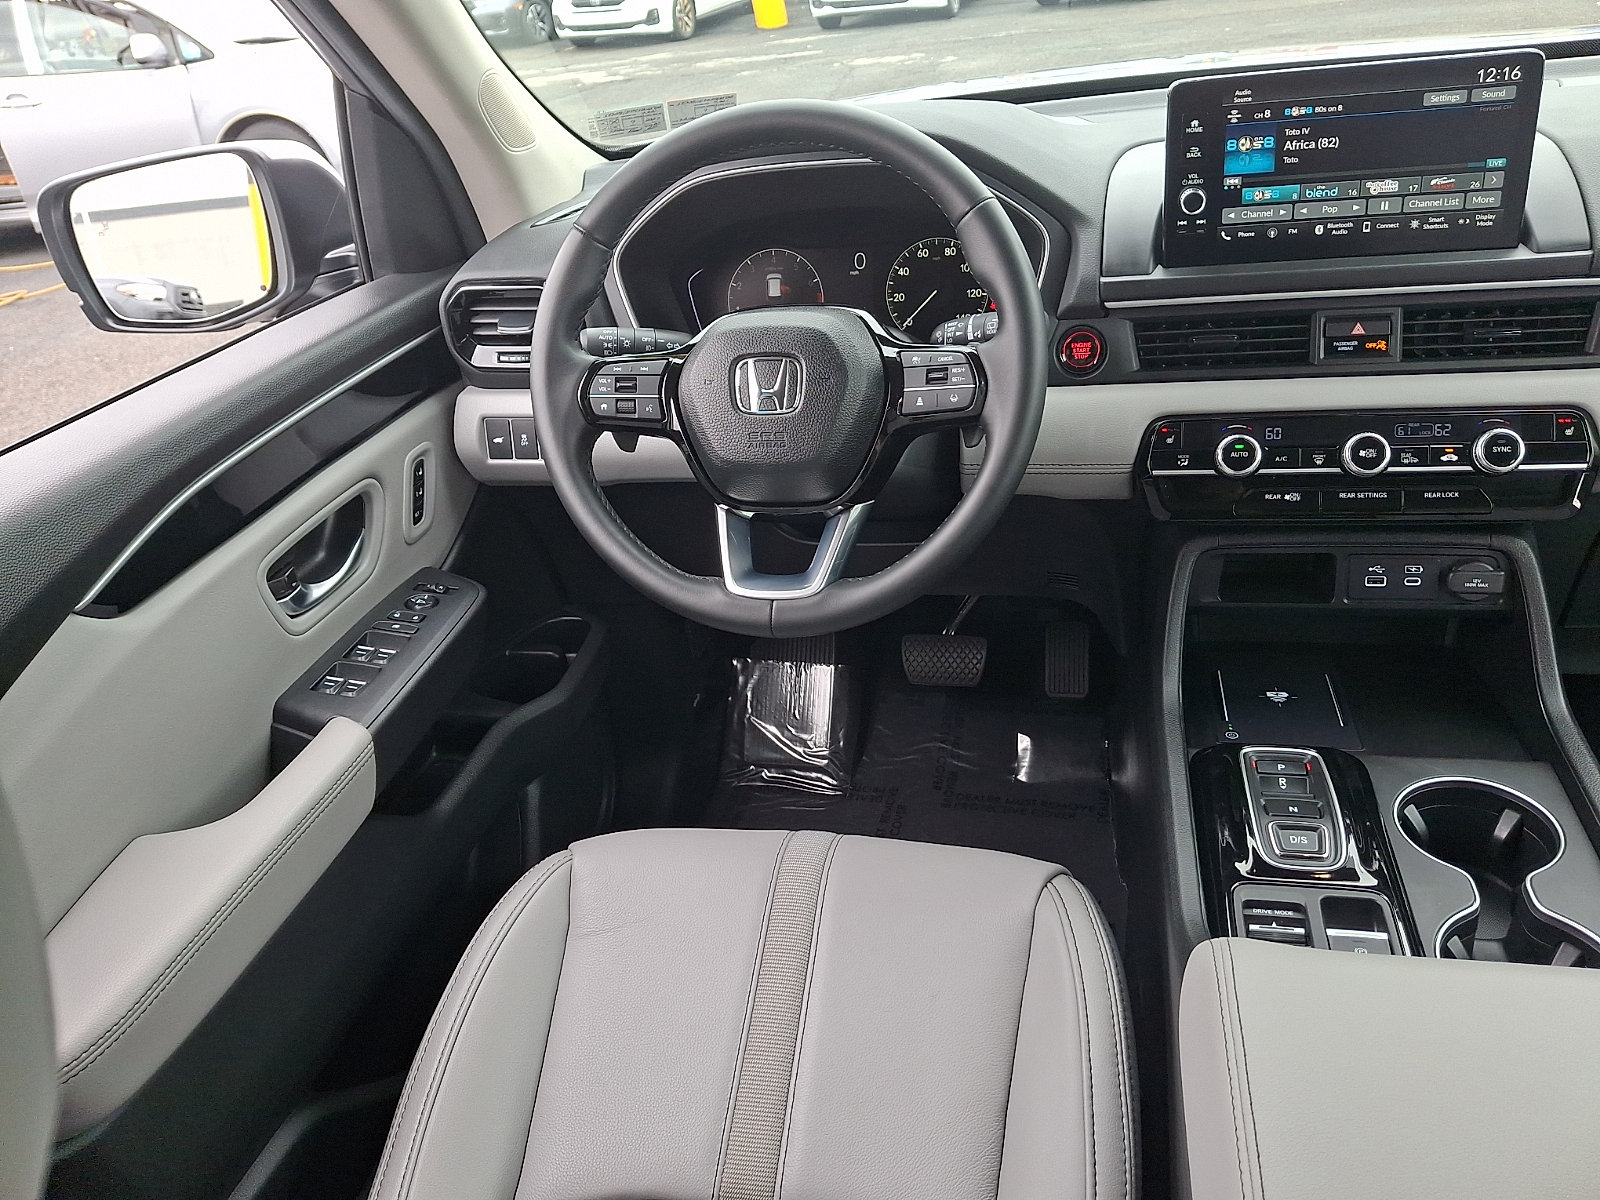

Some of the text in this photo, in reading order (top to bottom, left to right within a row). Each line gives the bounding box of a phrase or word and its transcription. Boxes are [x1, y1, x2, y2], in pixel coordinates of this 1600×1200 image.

[1477, 66, 1521, 83] 12:16
[1430, 94, 1460, 103] Settings
[1481, 89, 1506, 99] Sound
[1264, 109, 1271, 118] 8
[1285, 128, 1300, 136] Toto
[1283, 137, 1339, 151] Africa (82)
[1283, 156, 1299, 164] Toto
[1470, 181, 1480, 189] 26
[1305, 187, 1358, 198] blend 16
[1409, 199, 1442, 208] Channel
[1472, 196, 1495, 205] More
[1241, 209, 1274, 219] Channel
[1322, 205, 1338, 214] Pop
[1475, 213, 1496, 221] Display
[917, 249, 929, 257] 60
[944, 247, 957, 256] 80
[854, 252, 866, 270] 0
[897, 267, 910, 276] 40
[736, 282, 743, 290] 2
[893, 293, 905, 302] 20
[966, 288, 982, 298] 120
[1265, 427, 1282, 440] 60
[1434, 423, 1452, 437] 62
[1277, 763, 1286, 771] P
[1278, 777, 1287, 786] R
[1288, 805, 1298, 813] N
[1289, 835, 1308, 844] D/S
